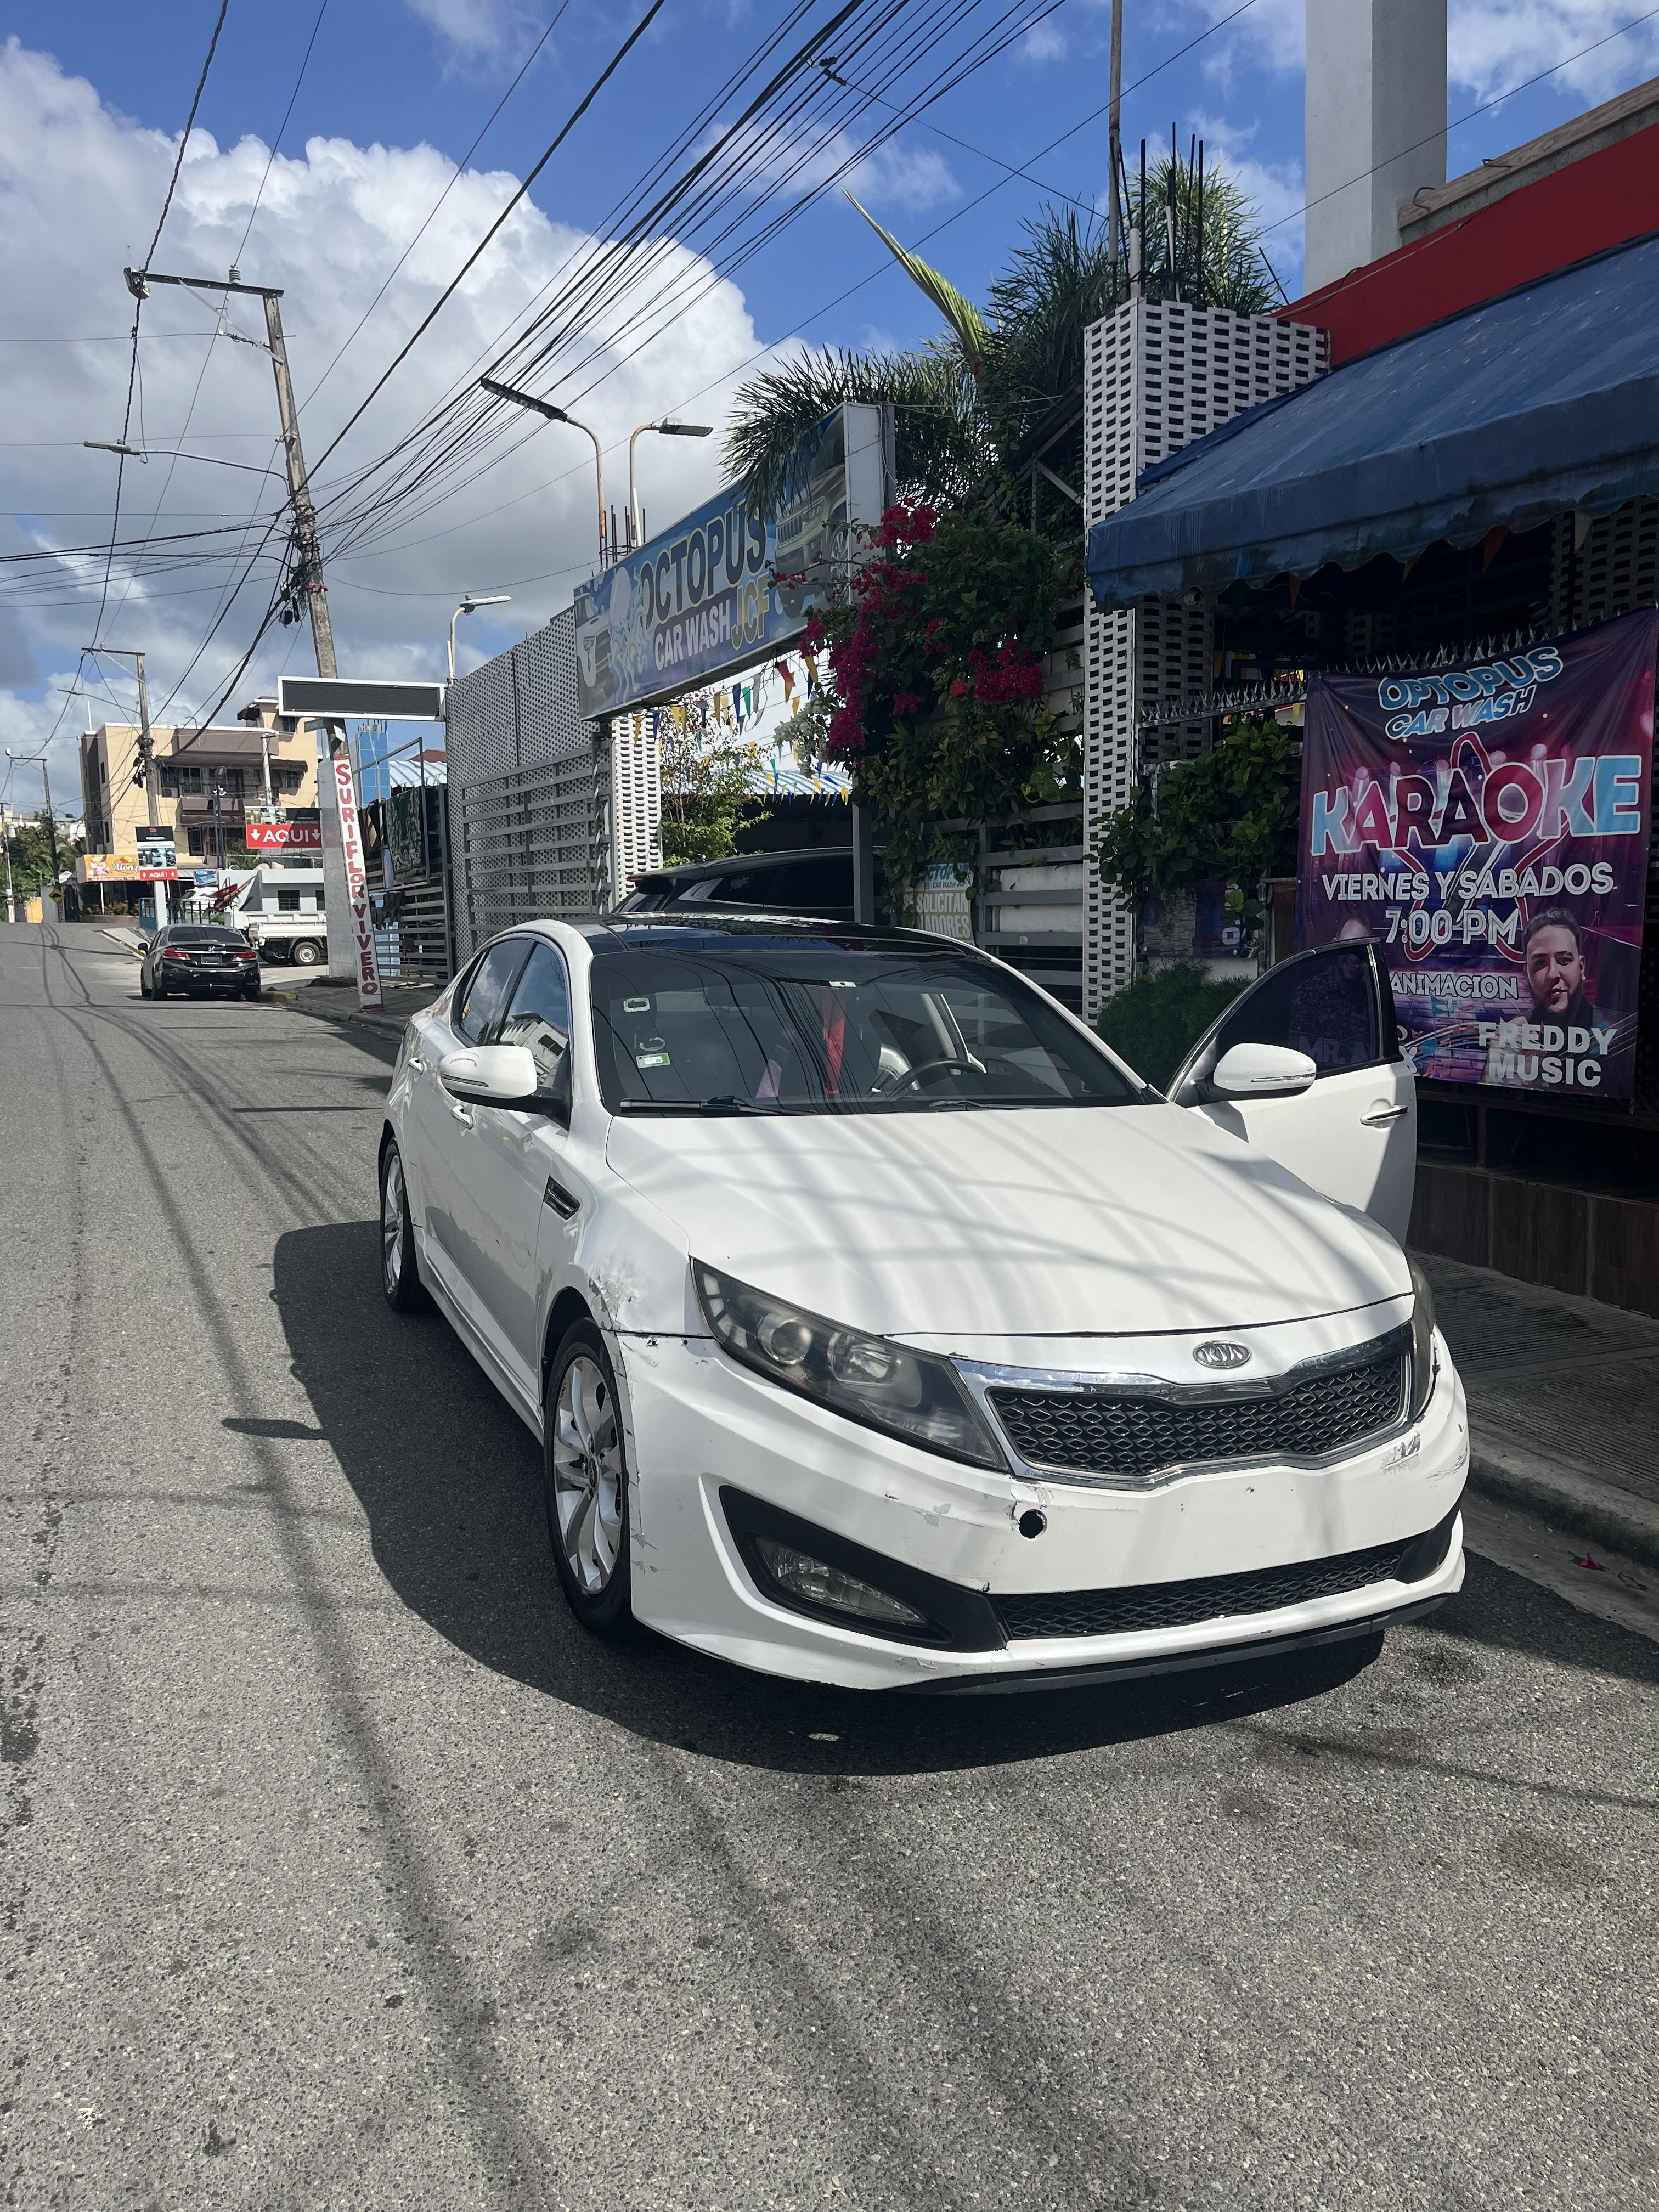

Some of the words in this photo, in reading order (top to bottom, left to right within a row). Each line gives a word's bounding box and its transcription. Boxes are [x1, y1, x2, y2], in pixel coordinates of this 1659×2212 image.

[640, 498, 768, 630] OCTOPUS
[654, 624, 684, 671] CAR
[685, 599, 730, 657] WASH
[731, 573, 769, 650] JCF
[1378, 646, 1564, 710] OPTOPUS
[1385, 707, 1449, 740] CAR
[1452, 684, 1537, 730] WASH
[1311, 755, 1642, 856] KARAOKE
[263, 829, 309, 843] AQUI
[336, 763, 365, 899] SURIFLOR
[353, 904, 378, 994] VIVERO
[1322, 871, 1430, 901] VIERNES
[1434, 871, 1456, 900] Y
[1457, 862, 1615, 900] SABADOS
[917, 893, 969, 913] SOLICITAN
[1385, 909, 1452, 945] 7:00
[1463, 908, 1519, 945] PM
[1391, 972, 1519, 1000] ANIMACION
[1478, 1022, 1617, 1056] FREDDY
[1489, 1052, 1602, 1087] MUSIC
[1201, 1345, 1244, 1363] KIA
